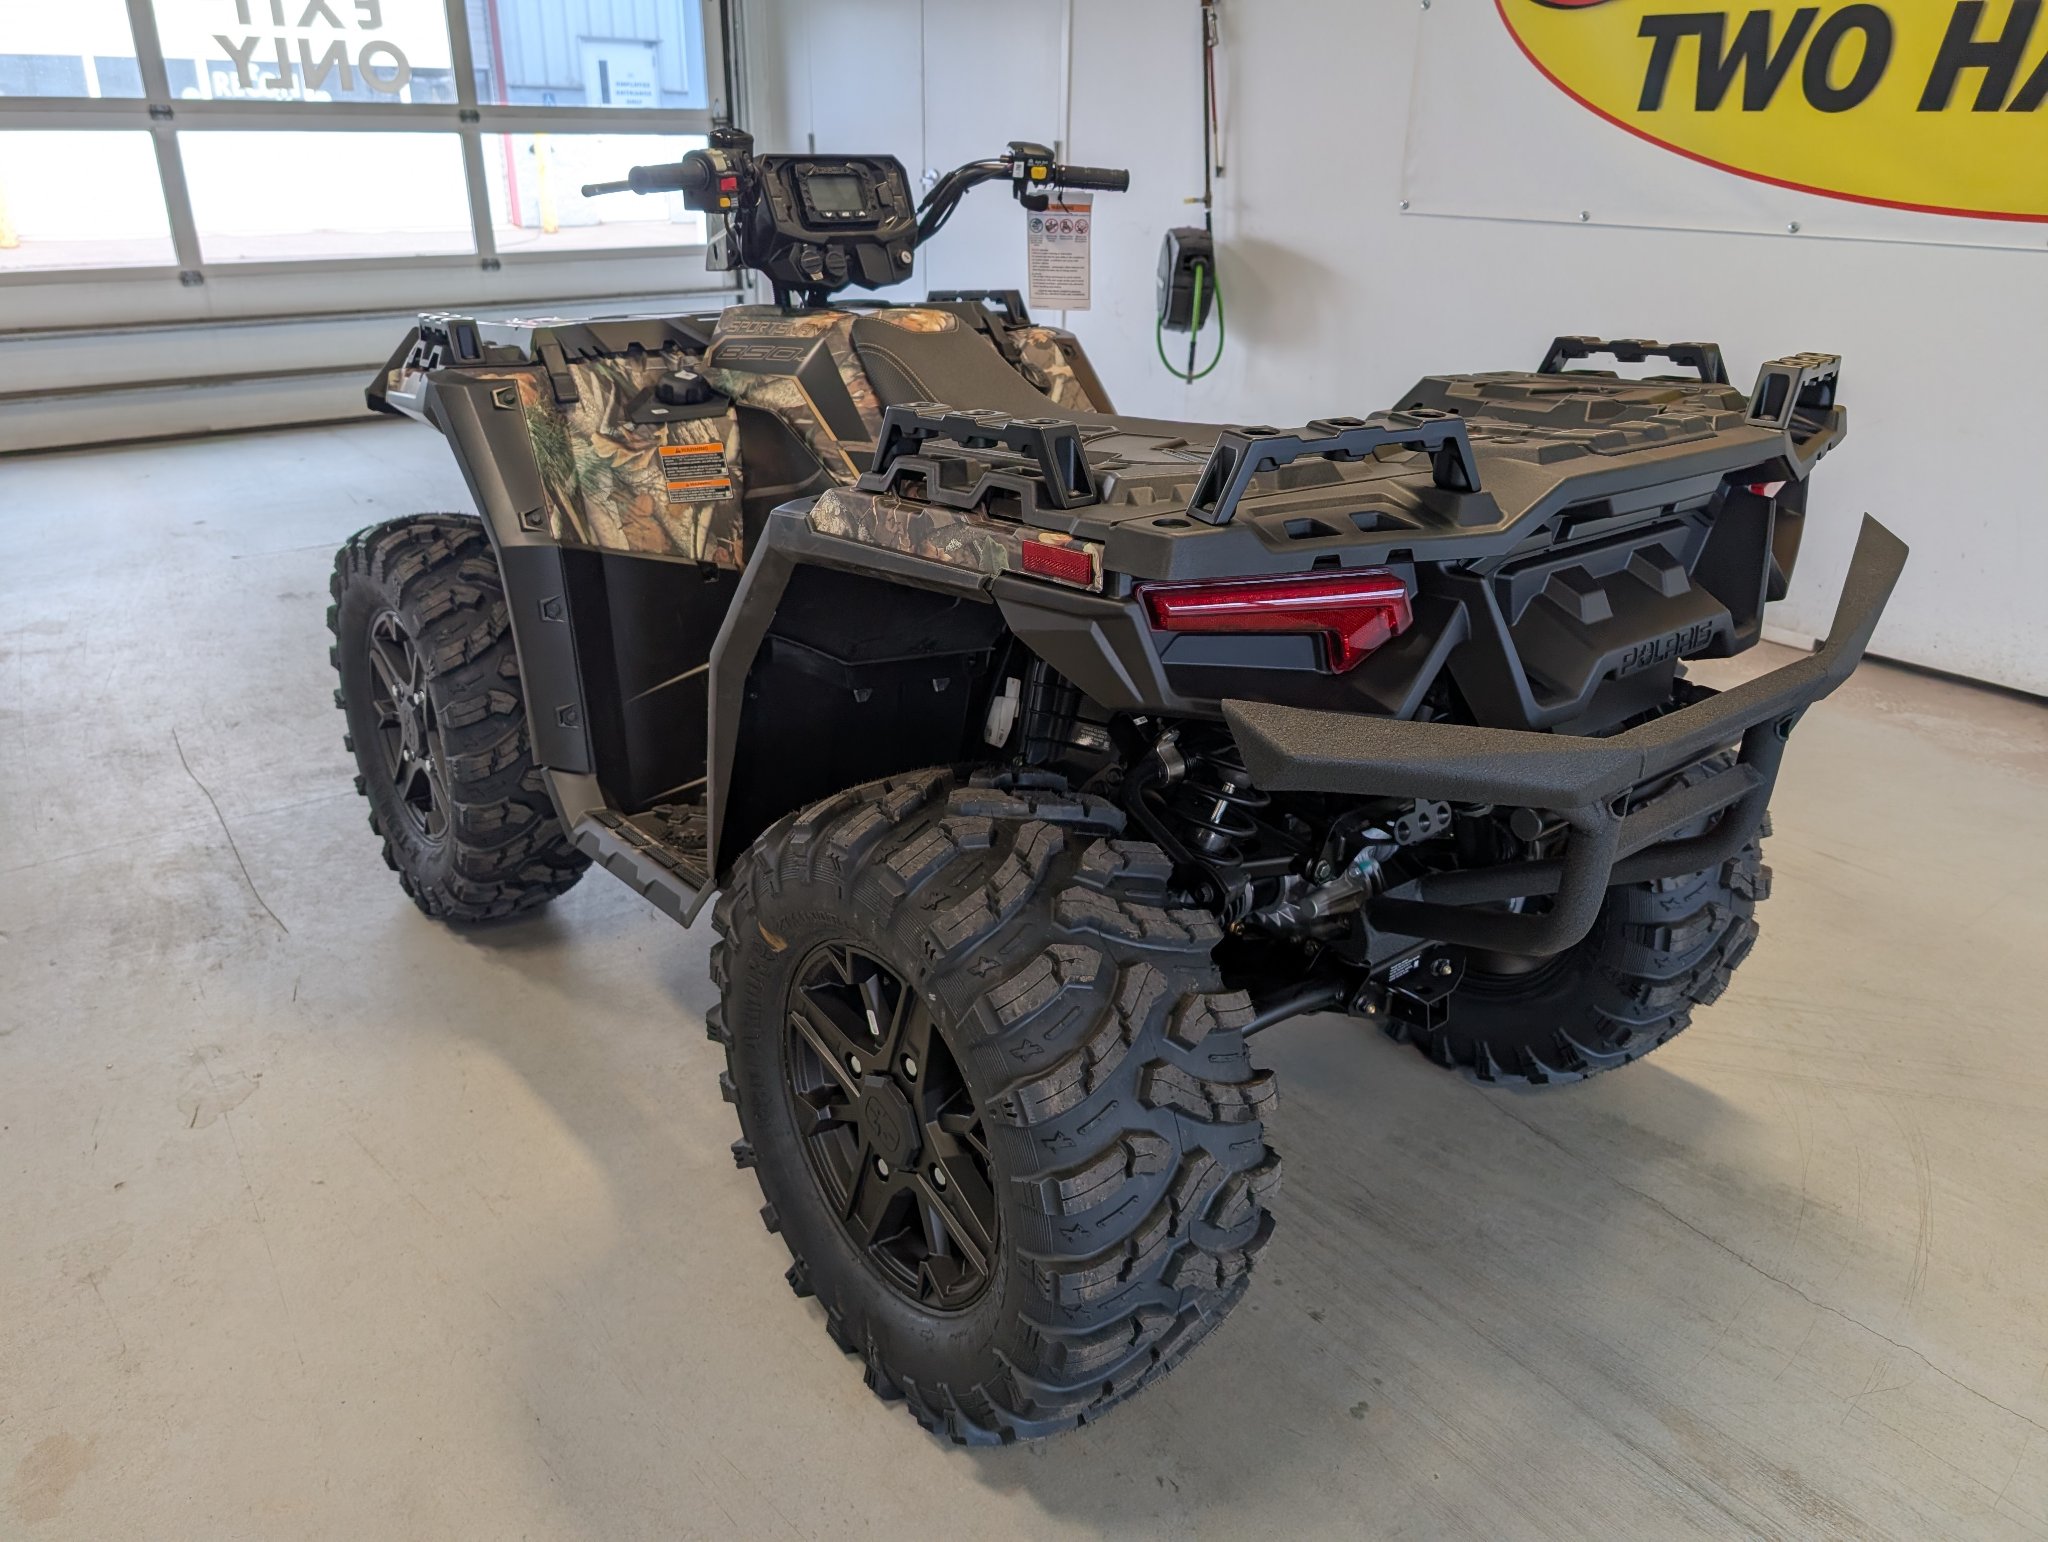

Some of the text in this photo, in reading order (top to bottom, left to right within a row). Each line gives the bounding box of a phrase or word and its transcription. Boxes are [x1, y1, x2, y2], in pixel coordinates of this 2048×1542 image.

[1637, 3, 1894, 113] TWO
[716, 344, 804, 362] 850
[1620, 620, 1713, 675] POLARIS
